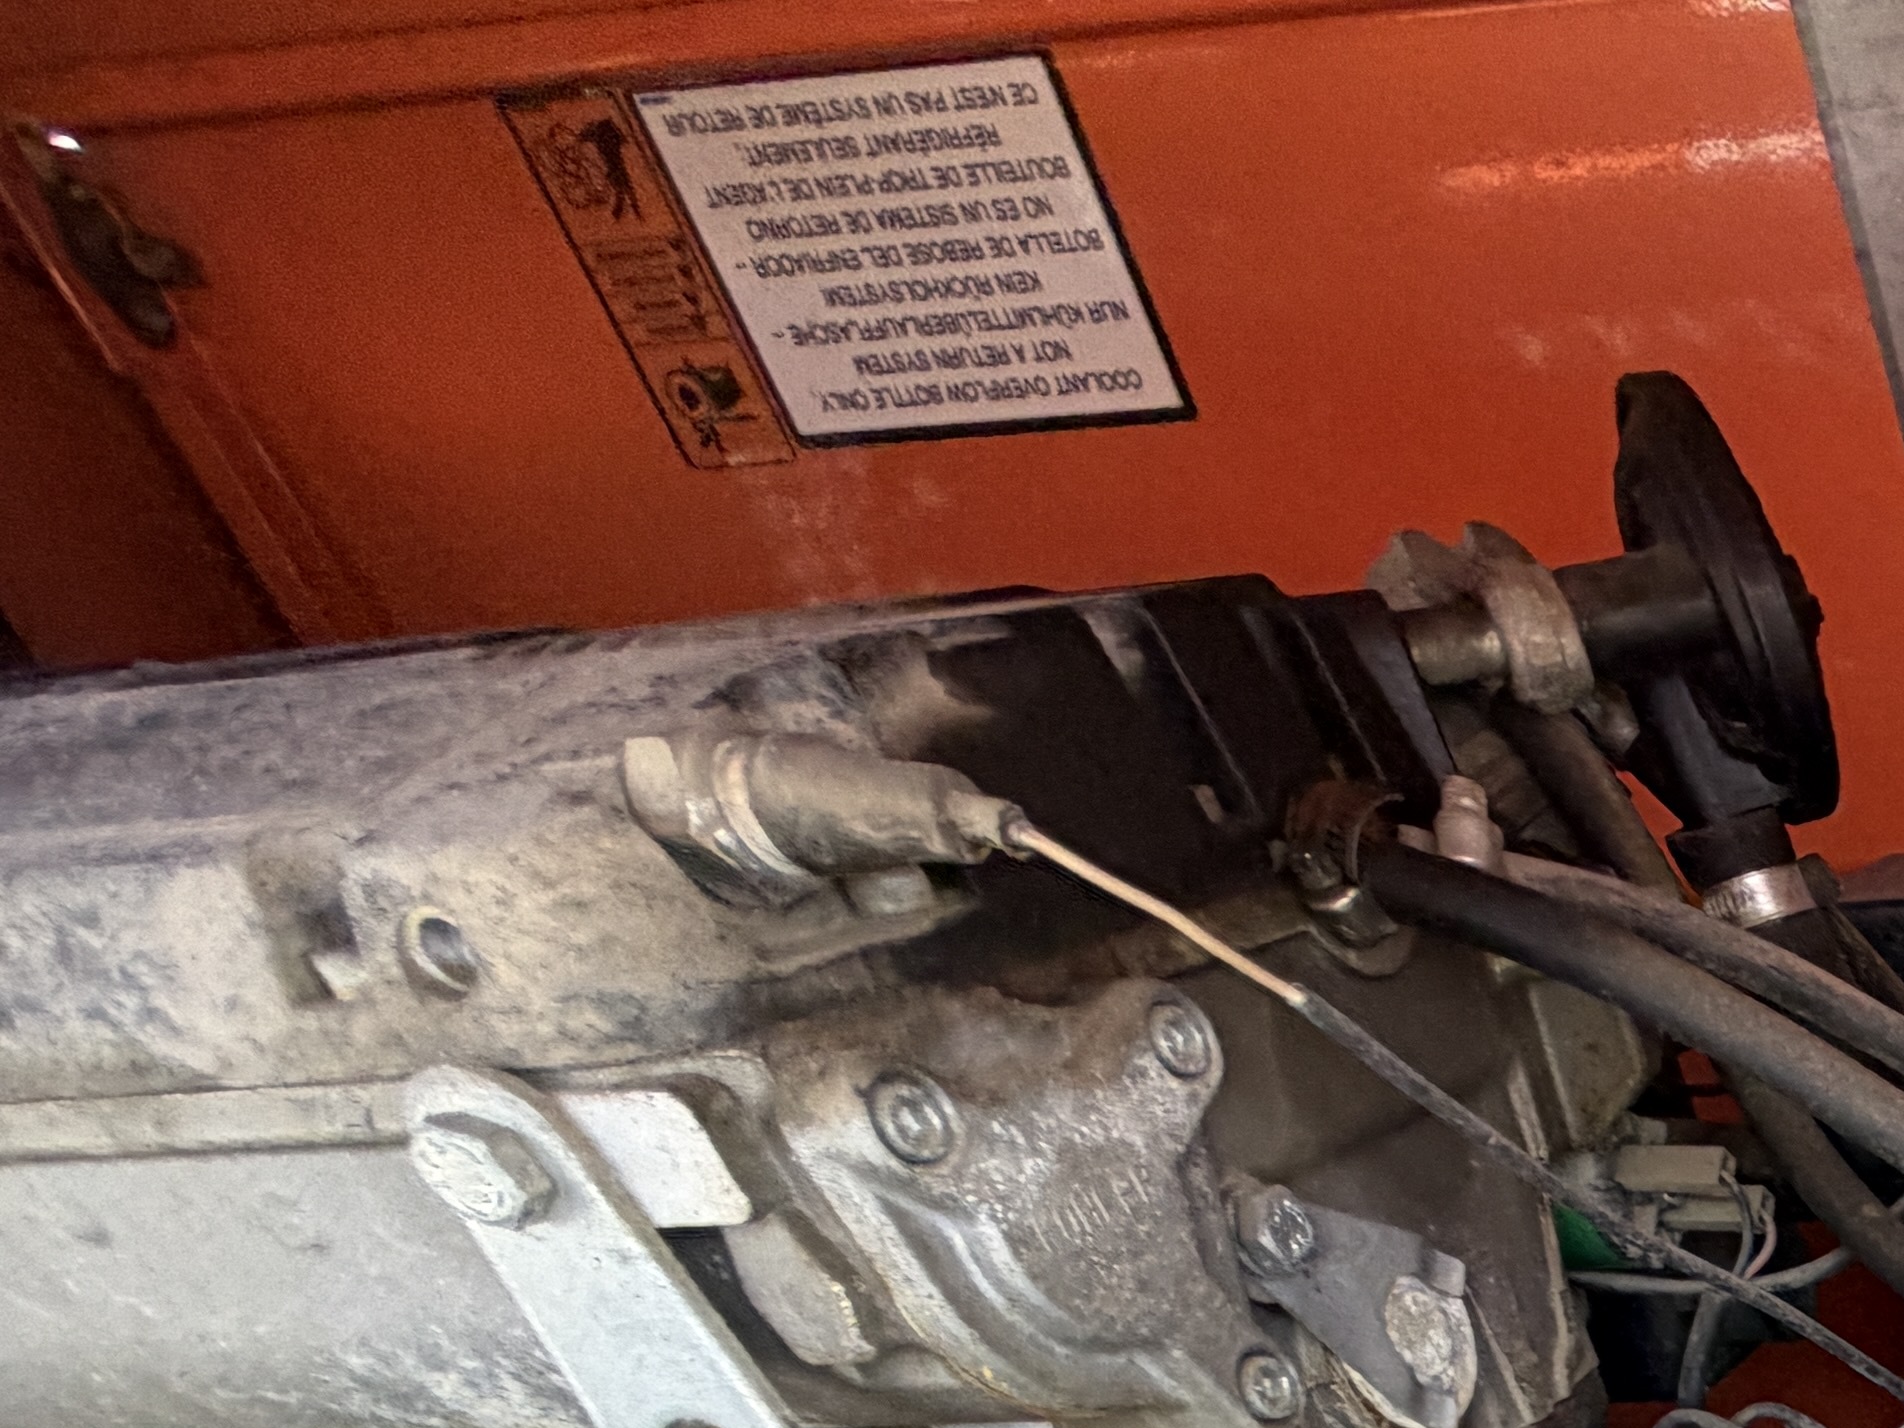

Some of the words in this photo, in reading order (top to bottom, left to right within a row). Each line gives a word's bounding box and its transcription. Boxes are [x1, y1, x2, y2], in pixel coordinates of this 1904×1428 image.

[904, 89, 946, 116] PAS
[1008, 82, 1038, 108] CE
[662, 109, 742, 138] RETOUR
[746, 105, 775, 131] DE
[931, 165, 961, 190] DE
[963, 156, 1071, 186] BOUTEILLE
[783, 178, 812, 204] DE
[872, 203, 956, 231] SISTEMA
[960, 201, 986, 226] UN
[990, 198, 1019, 221] ES
[1022, 195, 1054, 219] NO
[746, 214, 839, 239] RETORNO
[841, 210, 871, 236] DE
[902, 237, 985, 264] REBOSE
[988, 235, 1013, 258] DE
[1018, 228, 1104, 254] BOTELLA
[864, 244, 899, 267] DEL
[996, 270, 1041, 295] KEIN
[1087, 300, 1129, 324] NUR
[852, 349, 928, 376] SYSTEM
[931, 344, 1007, 370] RETURN
[1010, 342, 1025, 368] A
[1030, 340, 1072, 366] NOT
[946, 376, 1049, 404] OVERFLOW
[1054, 368, 1142, 396] COOLANT
[872, 384, 942, 409] BOTTLE
